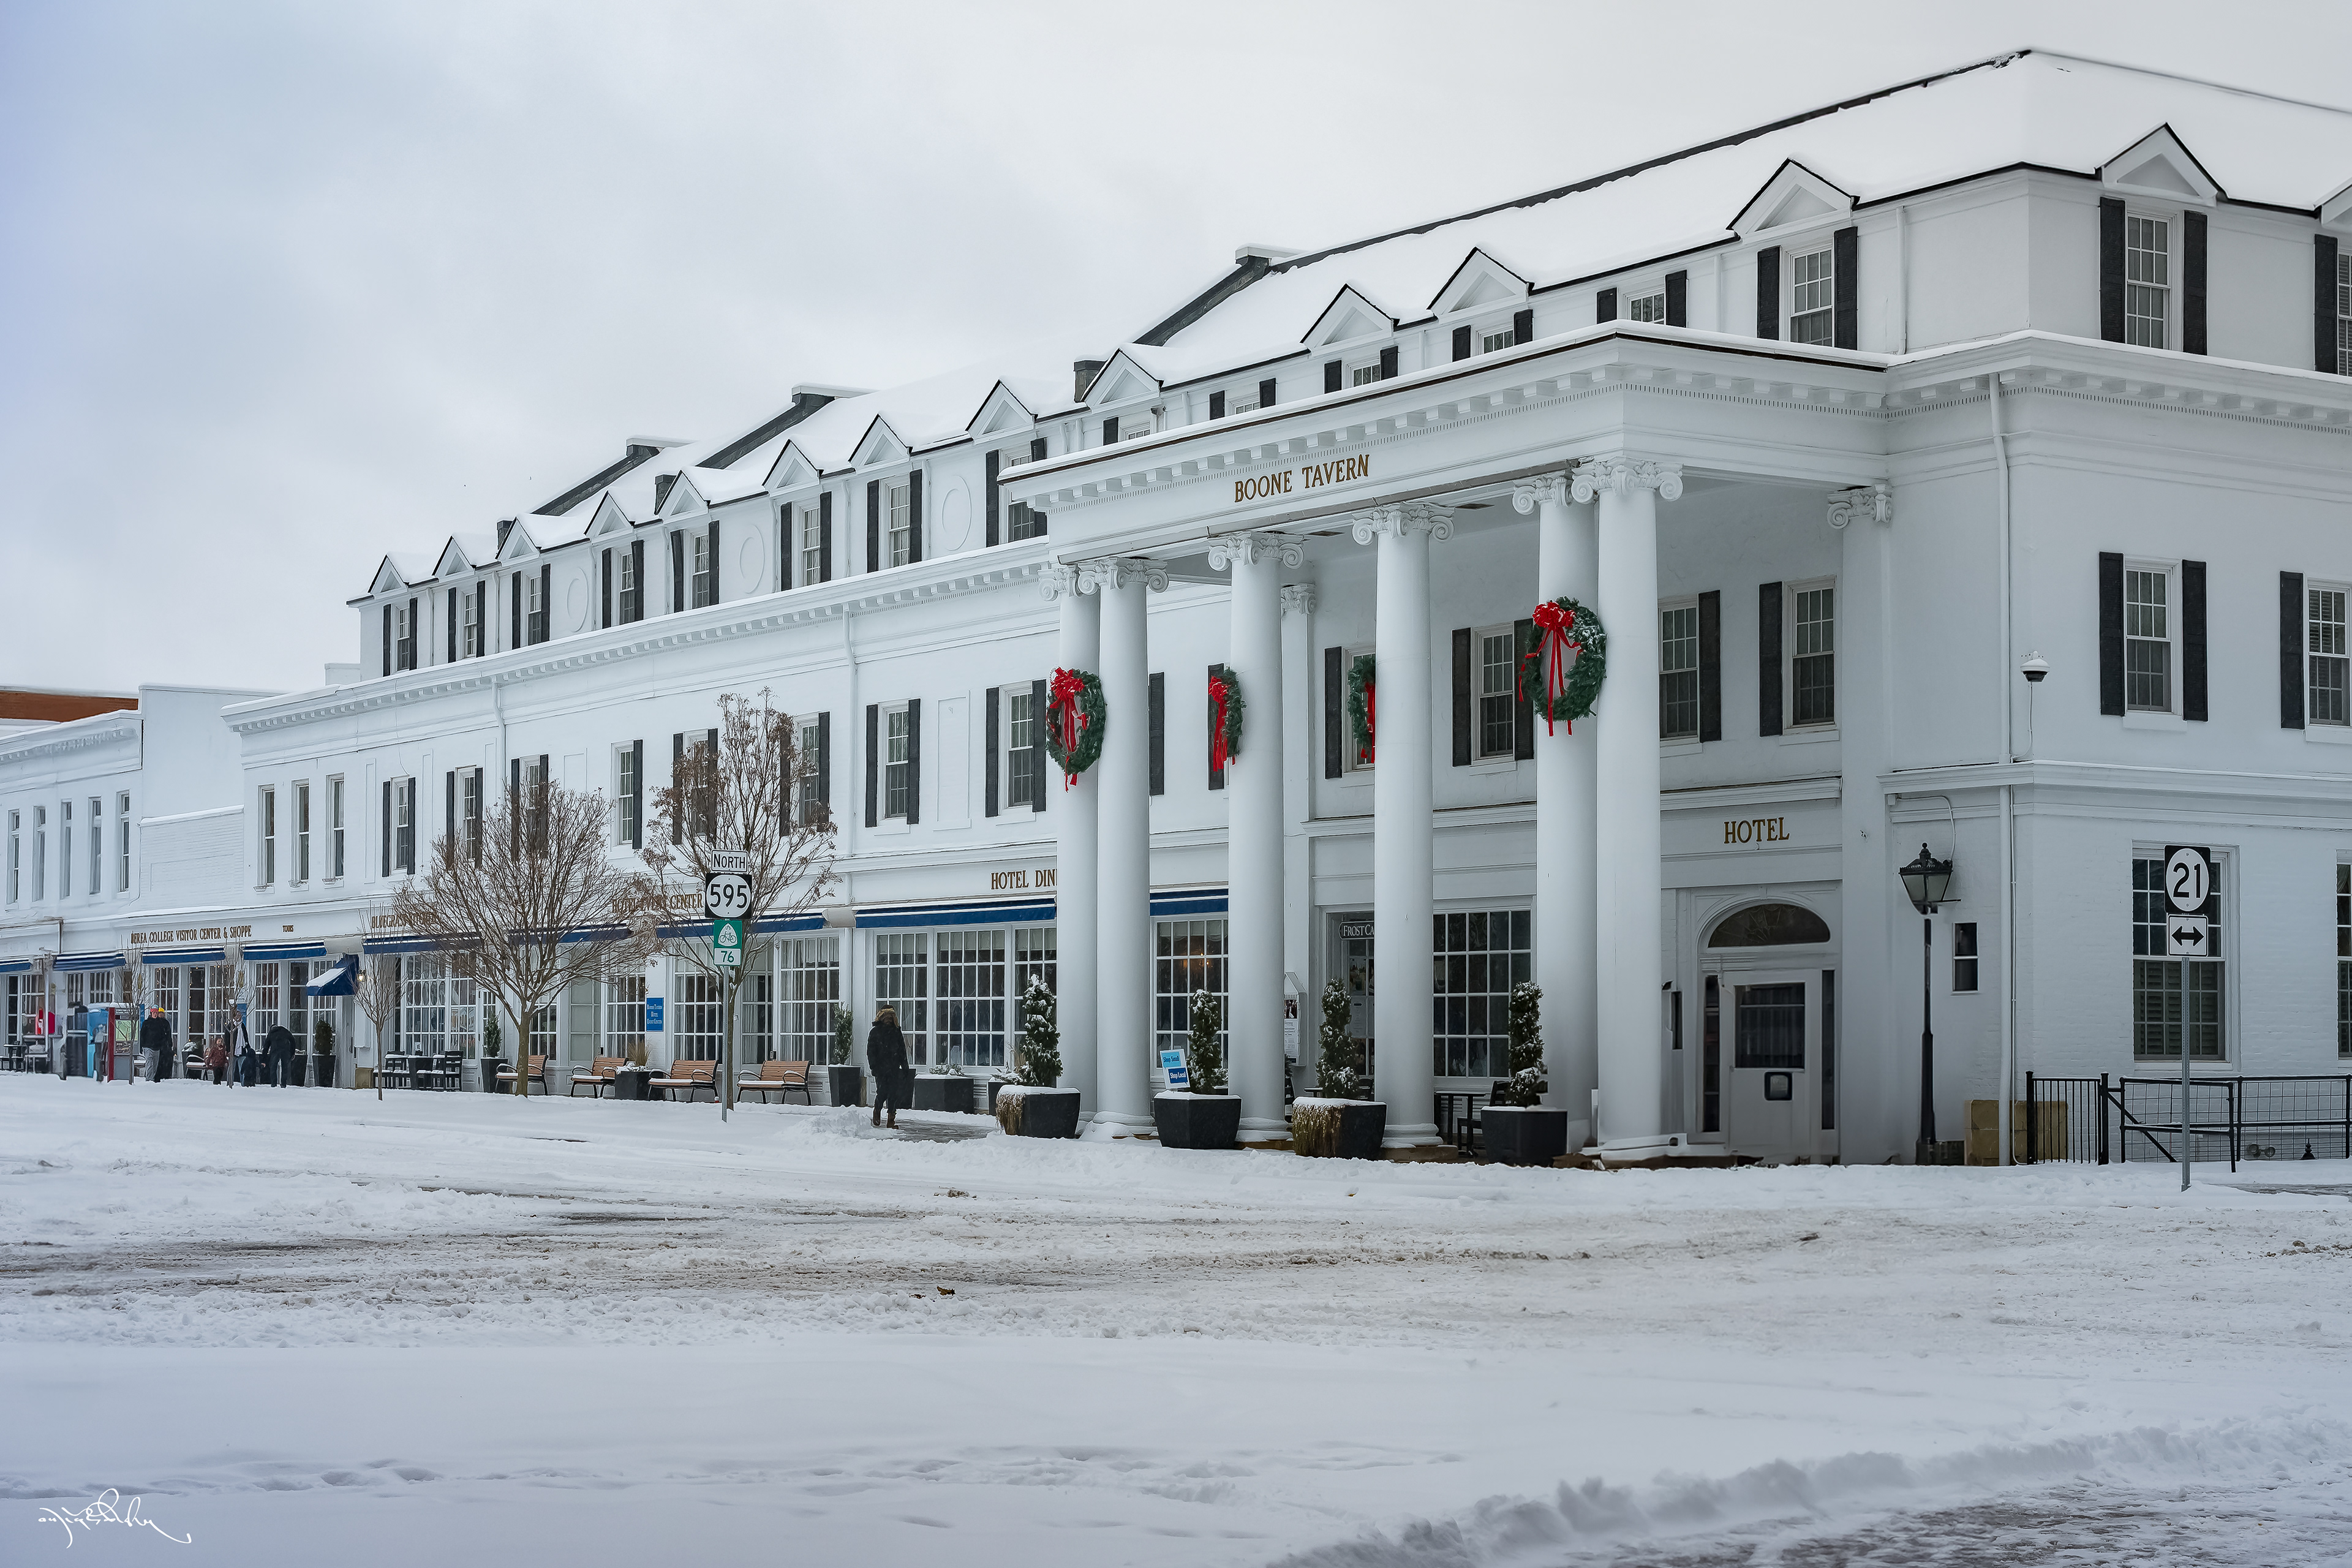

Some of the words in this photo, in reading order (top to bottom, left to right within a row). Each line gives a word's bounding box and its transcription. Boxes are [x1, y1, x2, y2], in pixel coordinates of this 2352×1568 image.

[1234, 470, 1292, 503] BOONE
[1302, 454, 1370, 489] TAVERN
[1724, 817, 1790, 843] HOTEL
[714, 853, 745, 869] NORTH
[991, 870, 1029, 889] HOTEL
[1035, 869, 1057, 888] DIN
[2173, 862, 2201, 899] 21
[670, 893, 704, 910] CENTER
[710, 883, 747, 909] 595
[130, 932, 147, 944] BEREA
[149, 930, 174, 943] COLLEGE
[176, 929, 198, 941] VISITOR
[200, 927, 222, 940] CENTER
[224, 927, 228, 938] &
[230, 925, 252, 938] SHOPPE
[1343, 925, 1365, 936] FROST
[720, 951, 734, 963] 76
